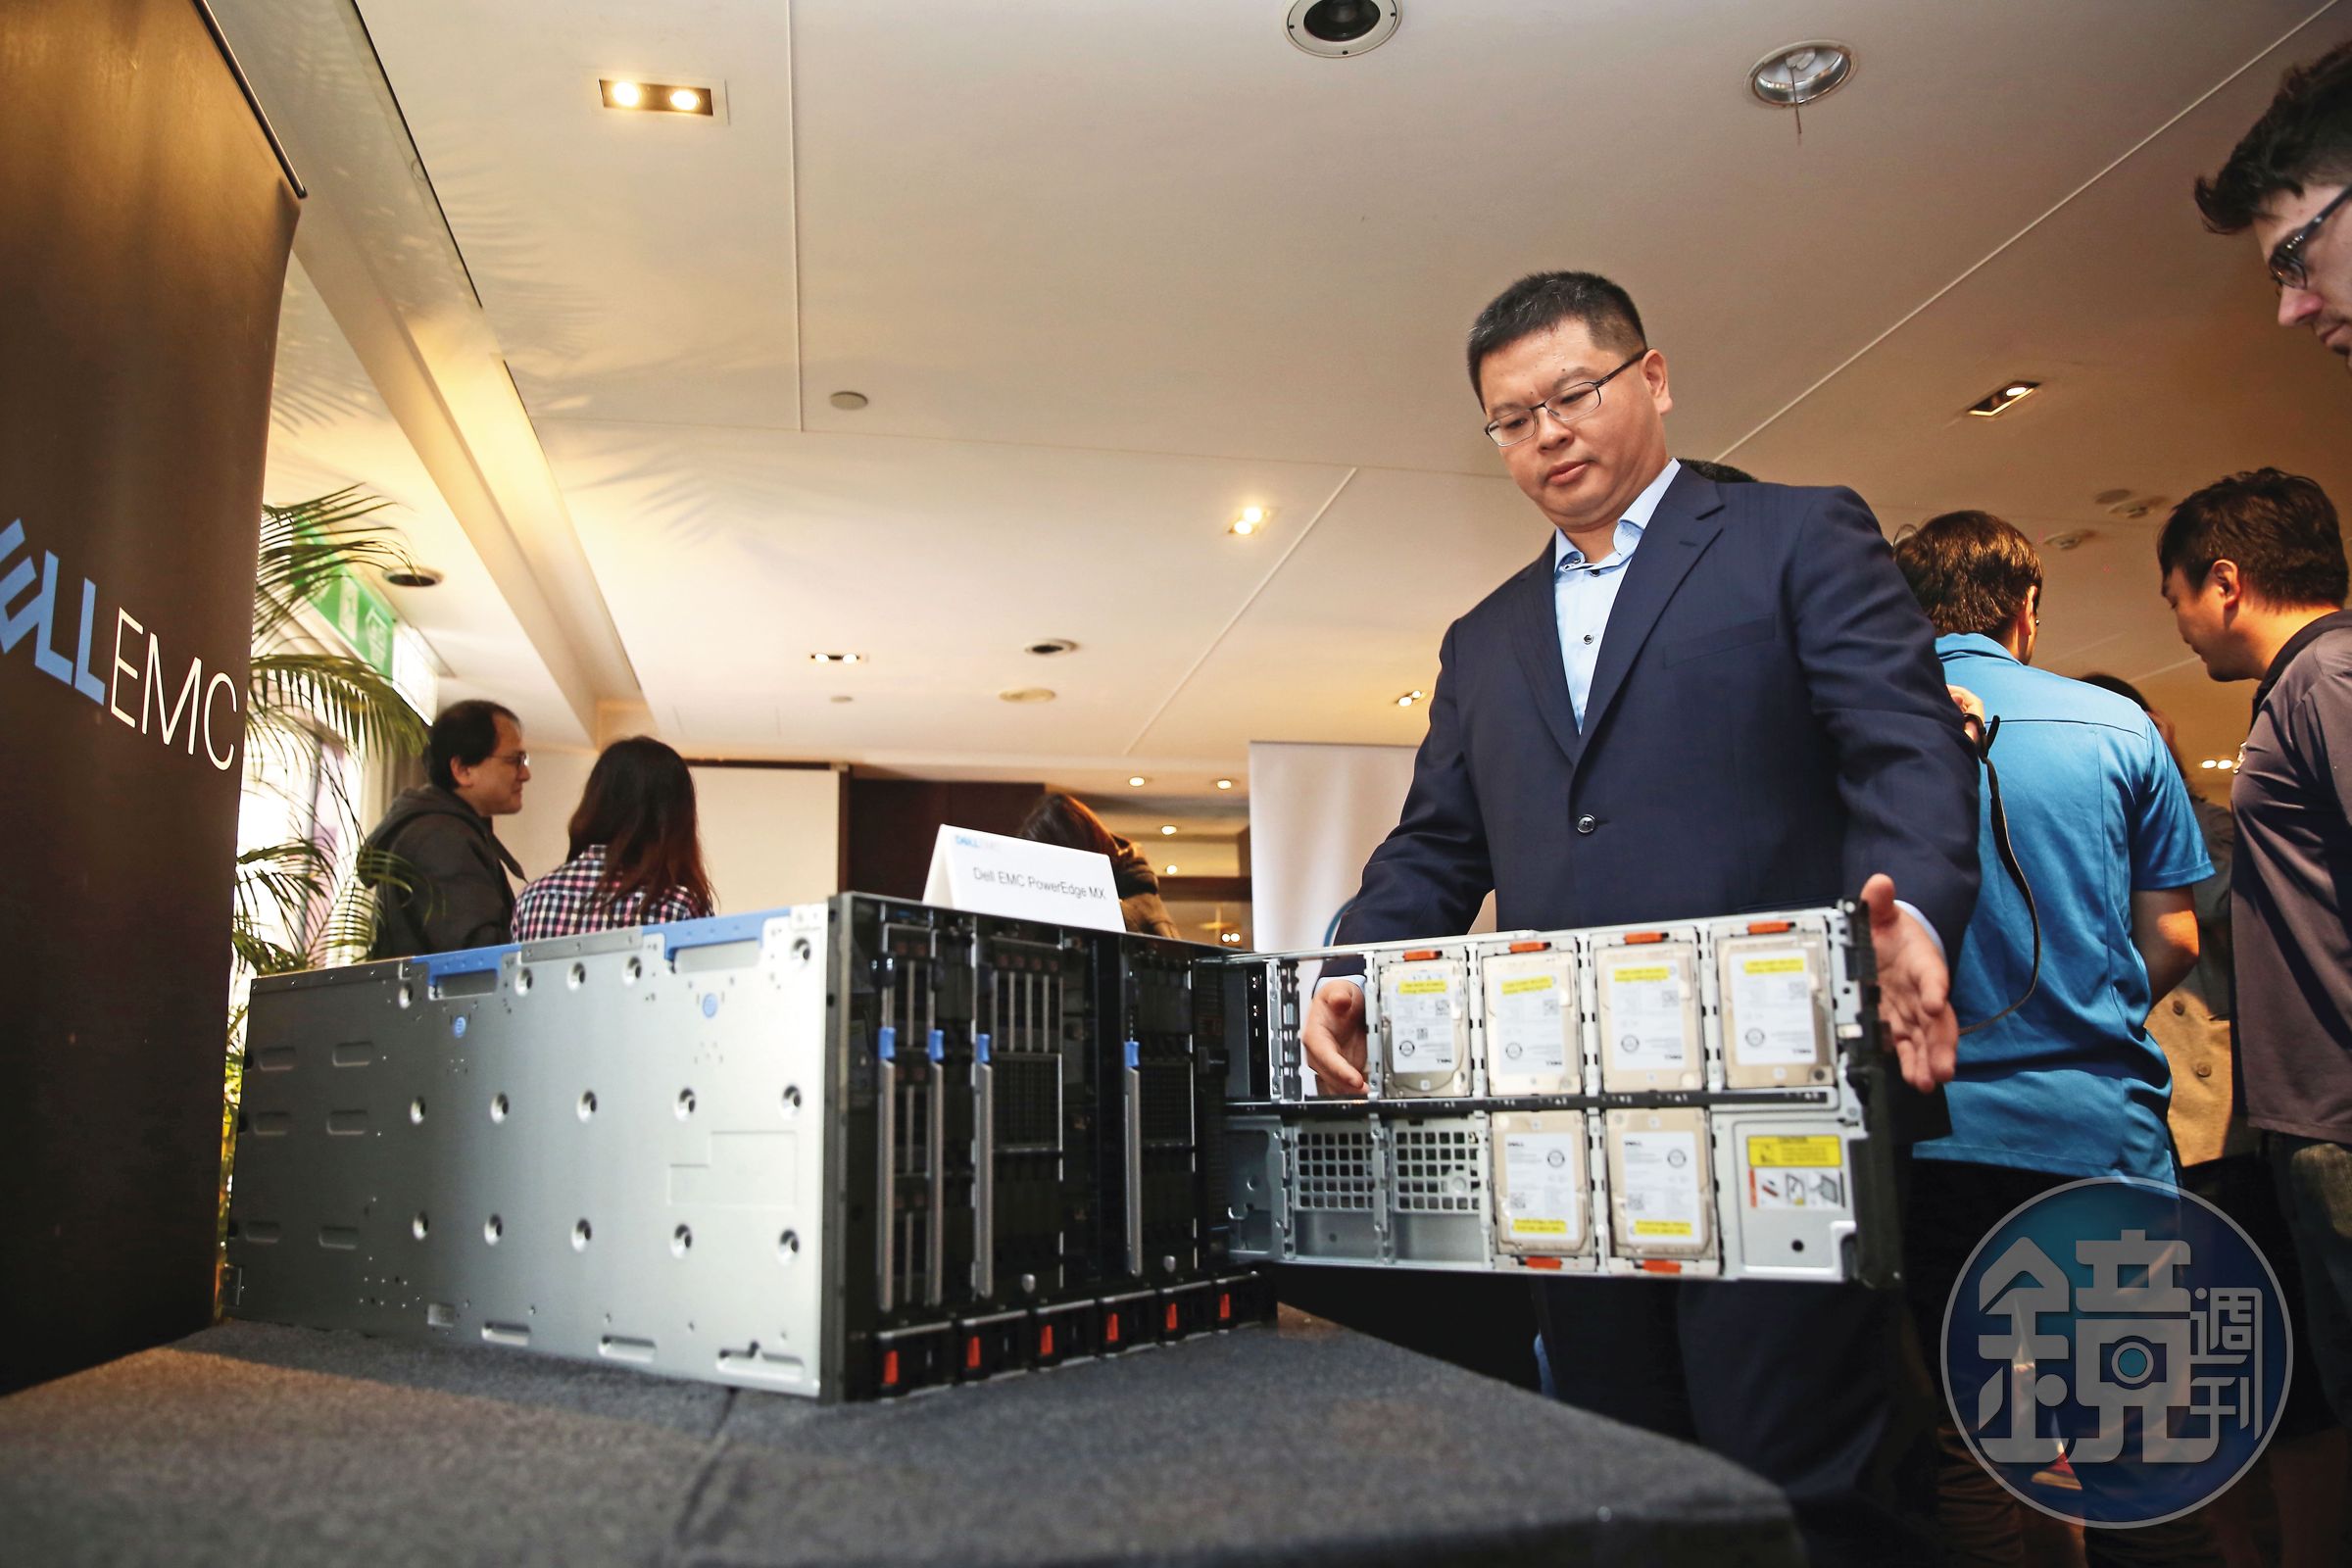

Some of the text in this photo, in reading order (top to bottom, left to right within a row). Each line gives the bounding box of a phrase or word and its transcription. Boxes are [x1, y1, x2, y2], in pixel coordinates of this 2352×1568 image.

[111, 607, 237, 771] EMC
[973, 866, 1106, 899] Dell EMC PowerEdge MX
